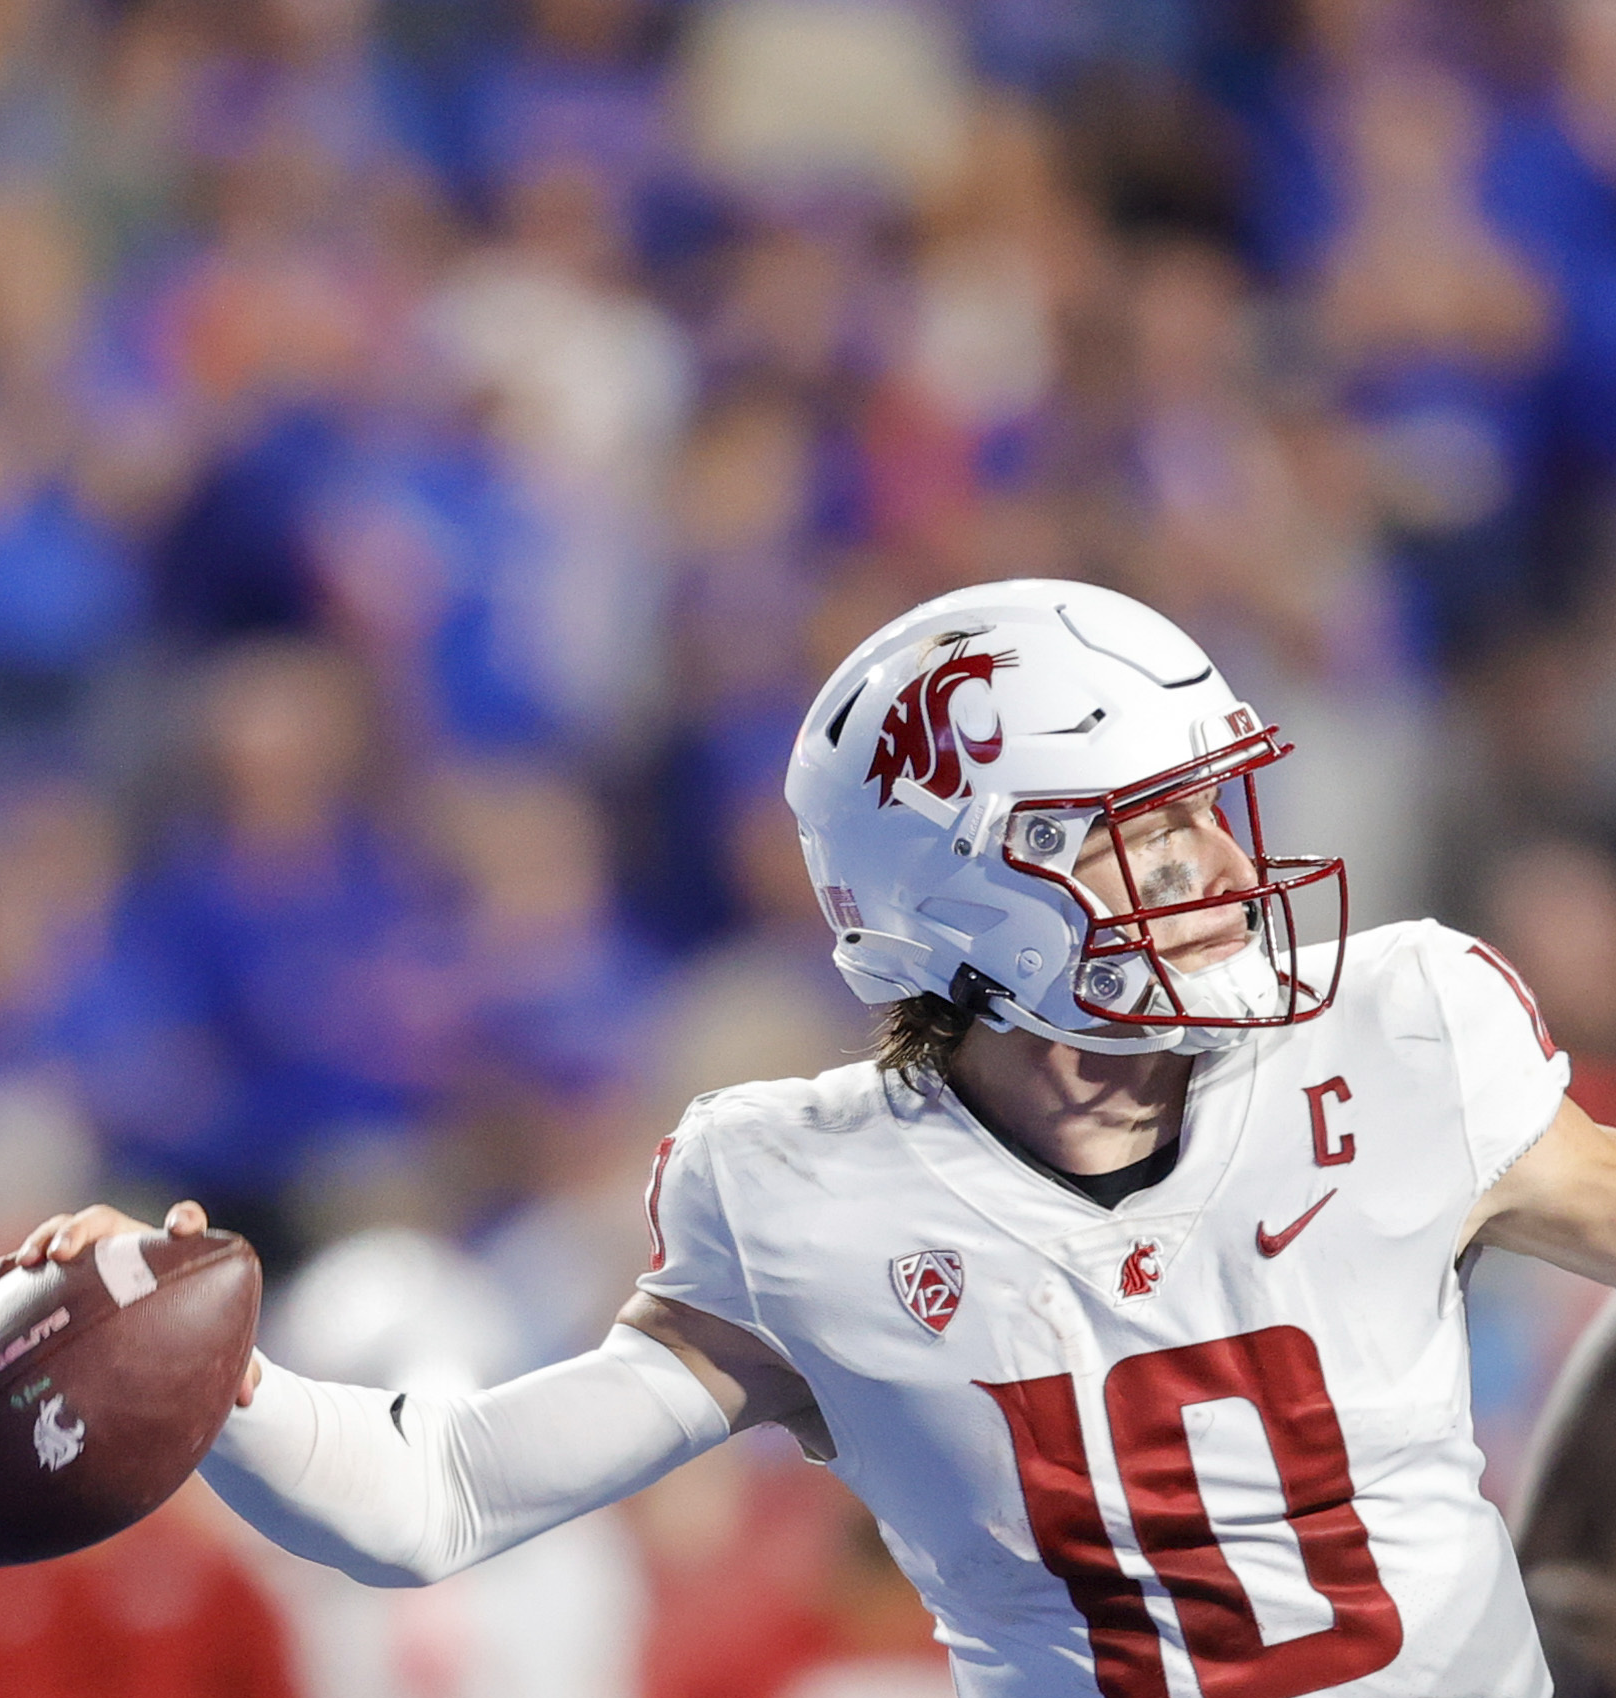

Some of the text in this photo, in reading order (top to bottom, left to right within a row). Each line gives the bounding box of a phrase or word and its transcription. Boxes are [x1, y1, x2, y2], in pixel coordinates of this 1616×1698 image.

[1300, 1075, 1356, 1168] C
[896, 1251, 962, 1305] PAC
[917, 1284, 954, 1319] 12
